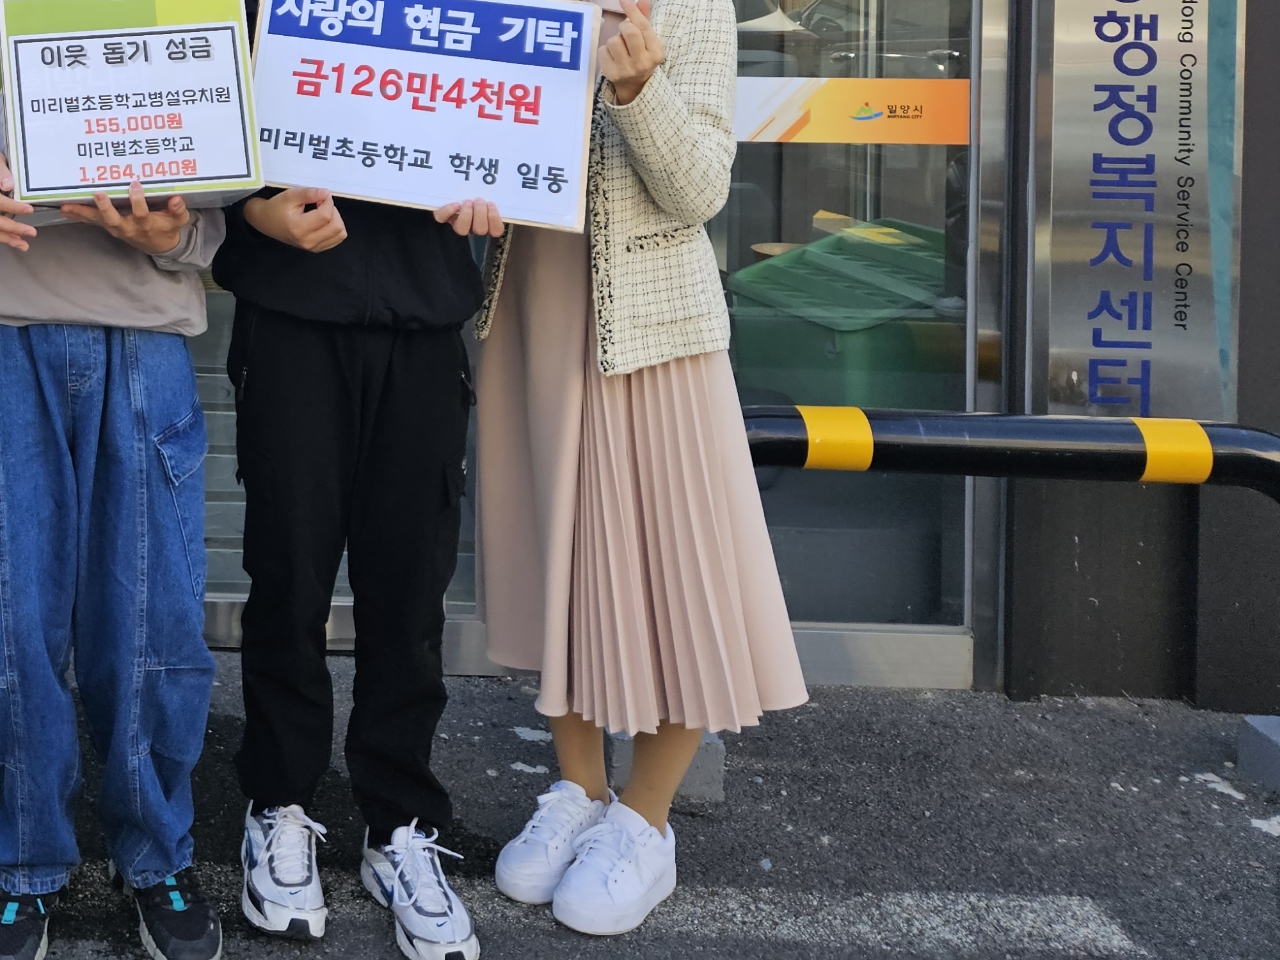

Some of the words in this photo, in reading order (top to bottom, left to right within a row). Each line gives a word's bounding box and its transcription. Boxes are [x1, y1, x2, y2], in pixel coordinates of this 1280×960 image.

[40, 44, 87, 68] 이웃
[102, 40, 150, 65] 돕기
[165, 36, 213, 60] 성금
[404, 4, 481, 52] 현금
[498, 16, 579, 63] 기탁
[30, 86, 232, 114] 미리벌초등학교병설유치원
[292, 57, 543, 126] 금126만4천원
[886, 104, 923, 115] 밀양시
[1176, 52, 1197, 167] Community
[83, 112, 184, 135] 155,000원
[77, 136, 196, 159] 미리벌초등학교
[259, 127, 433, 172] 미리벌초등학교
[448, 152, 500, 186] 학생
[516, 163, 569, 194] 일동
[79, 158, 198, 183] 1,264,040원
[1176, 176, 1195, 253] Service
[1173, 262, 1193, 331] Center
